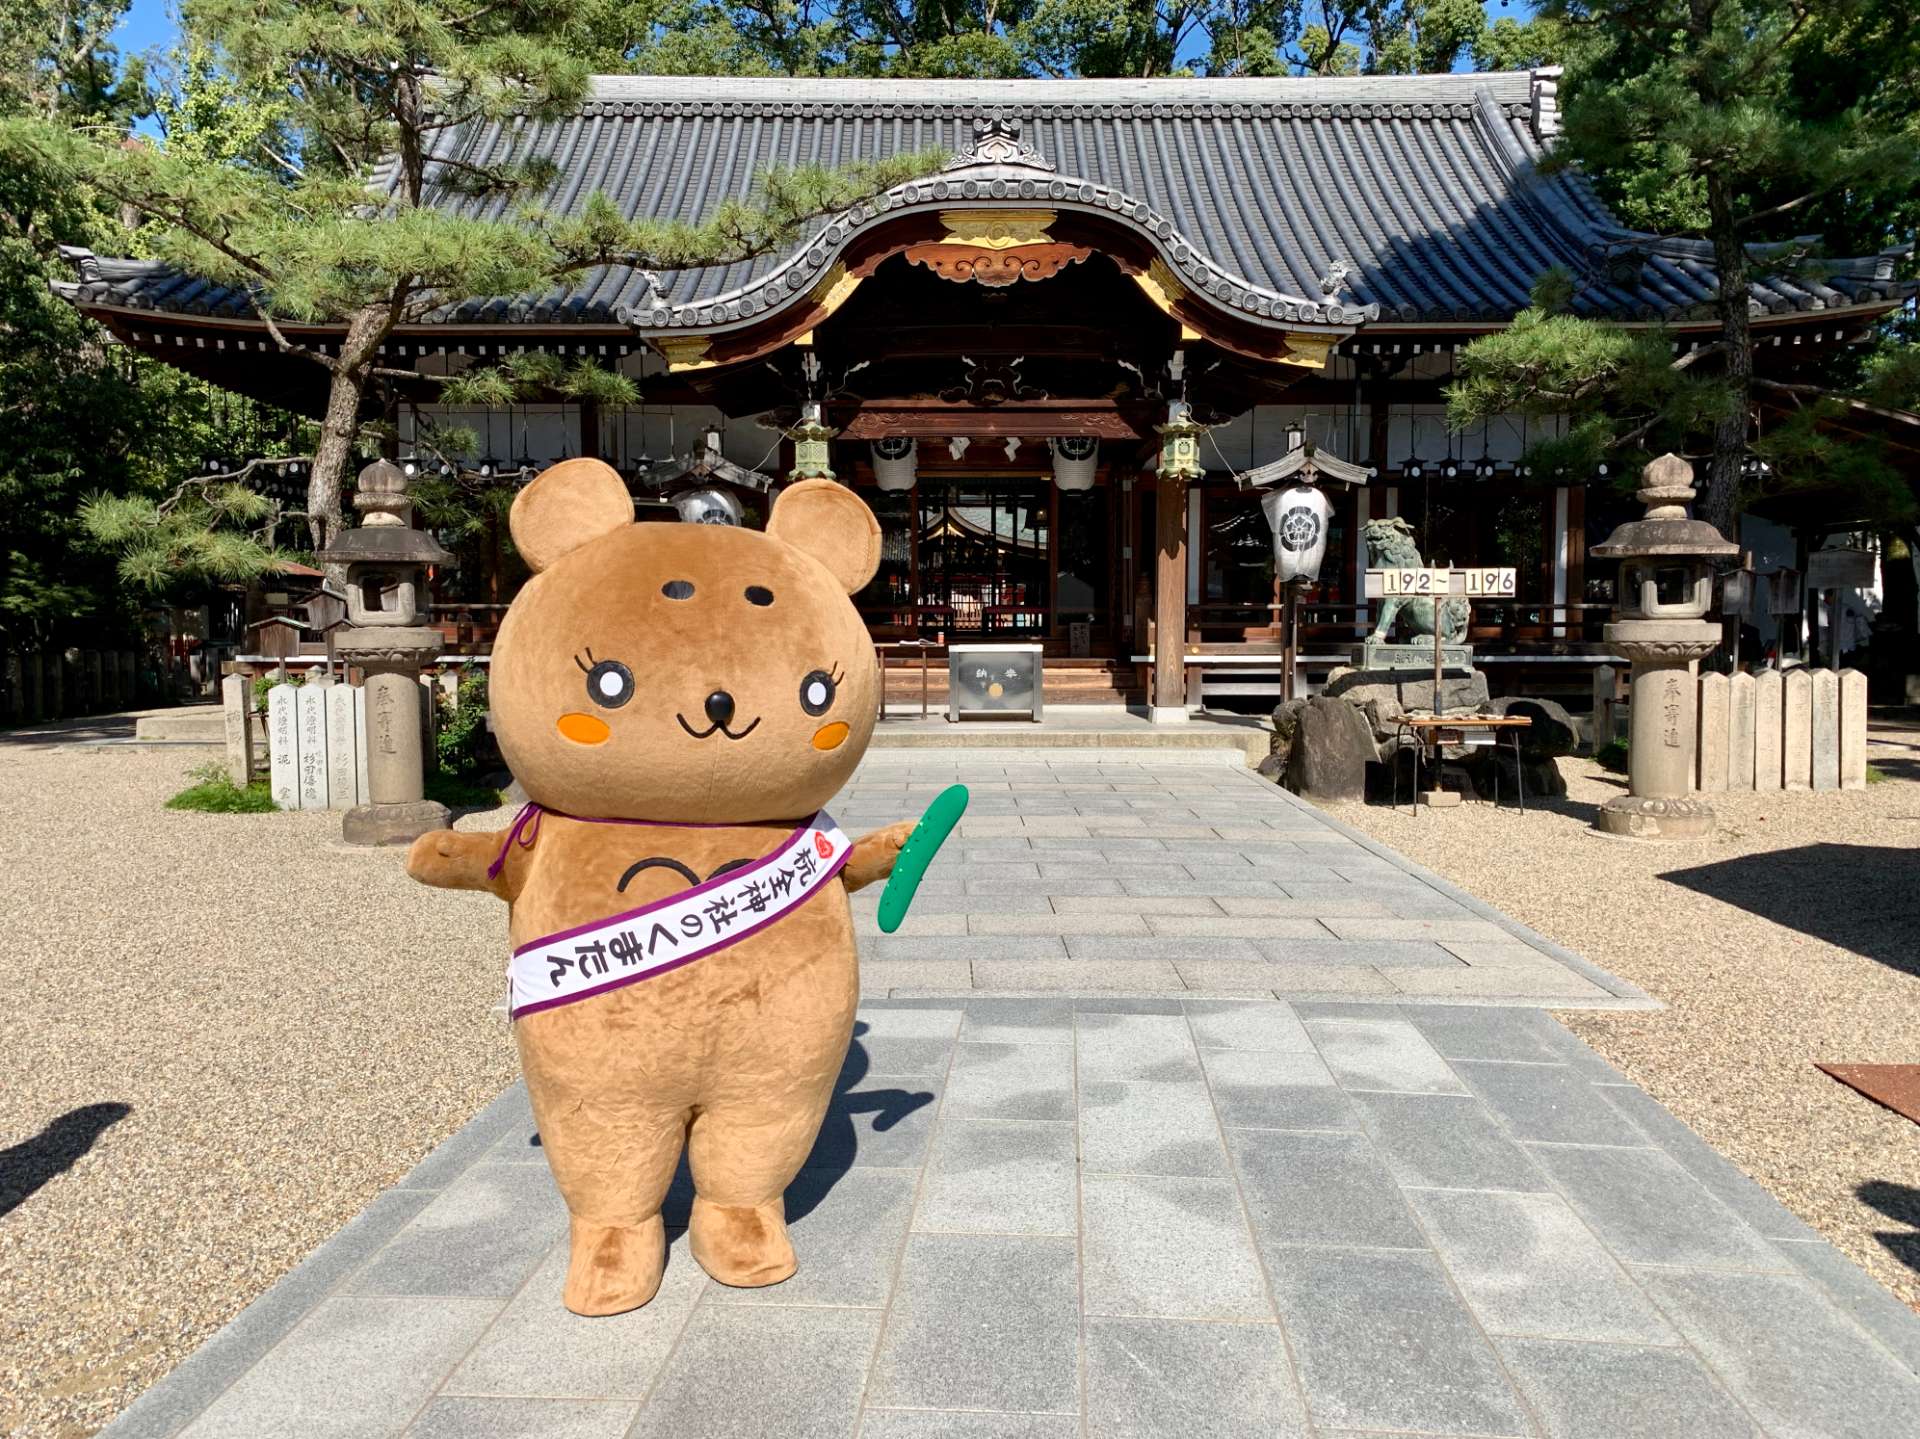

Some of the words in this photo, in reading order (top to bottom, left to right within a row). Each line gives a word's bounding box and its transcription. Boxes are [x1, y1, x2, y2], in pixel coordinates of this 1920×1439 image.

[1469, 572, 1514, 592] 196
[546, 847, 819, 988] 杭全神社のくまたん
